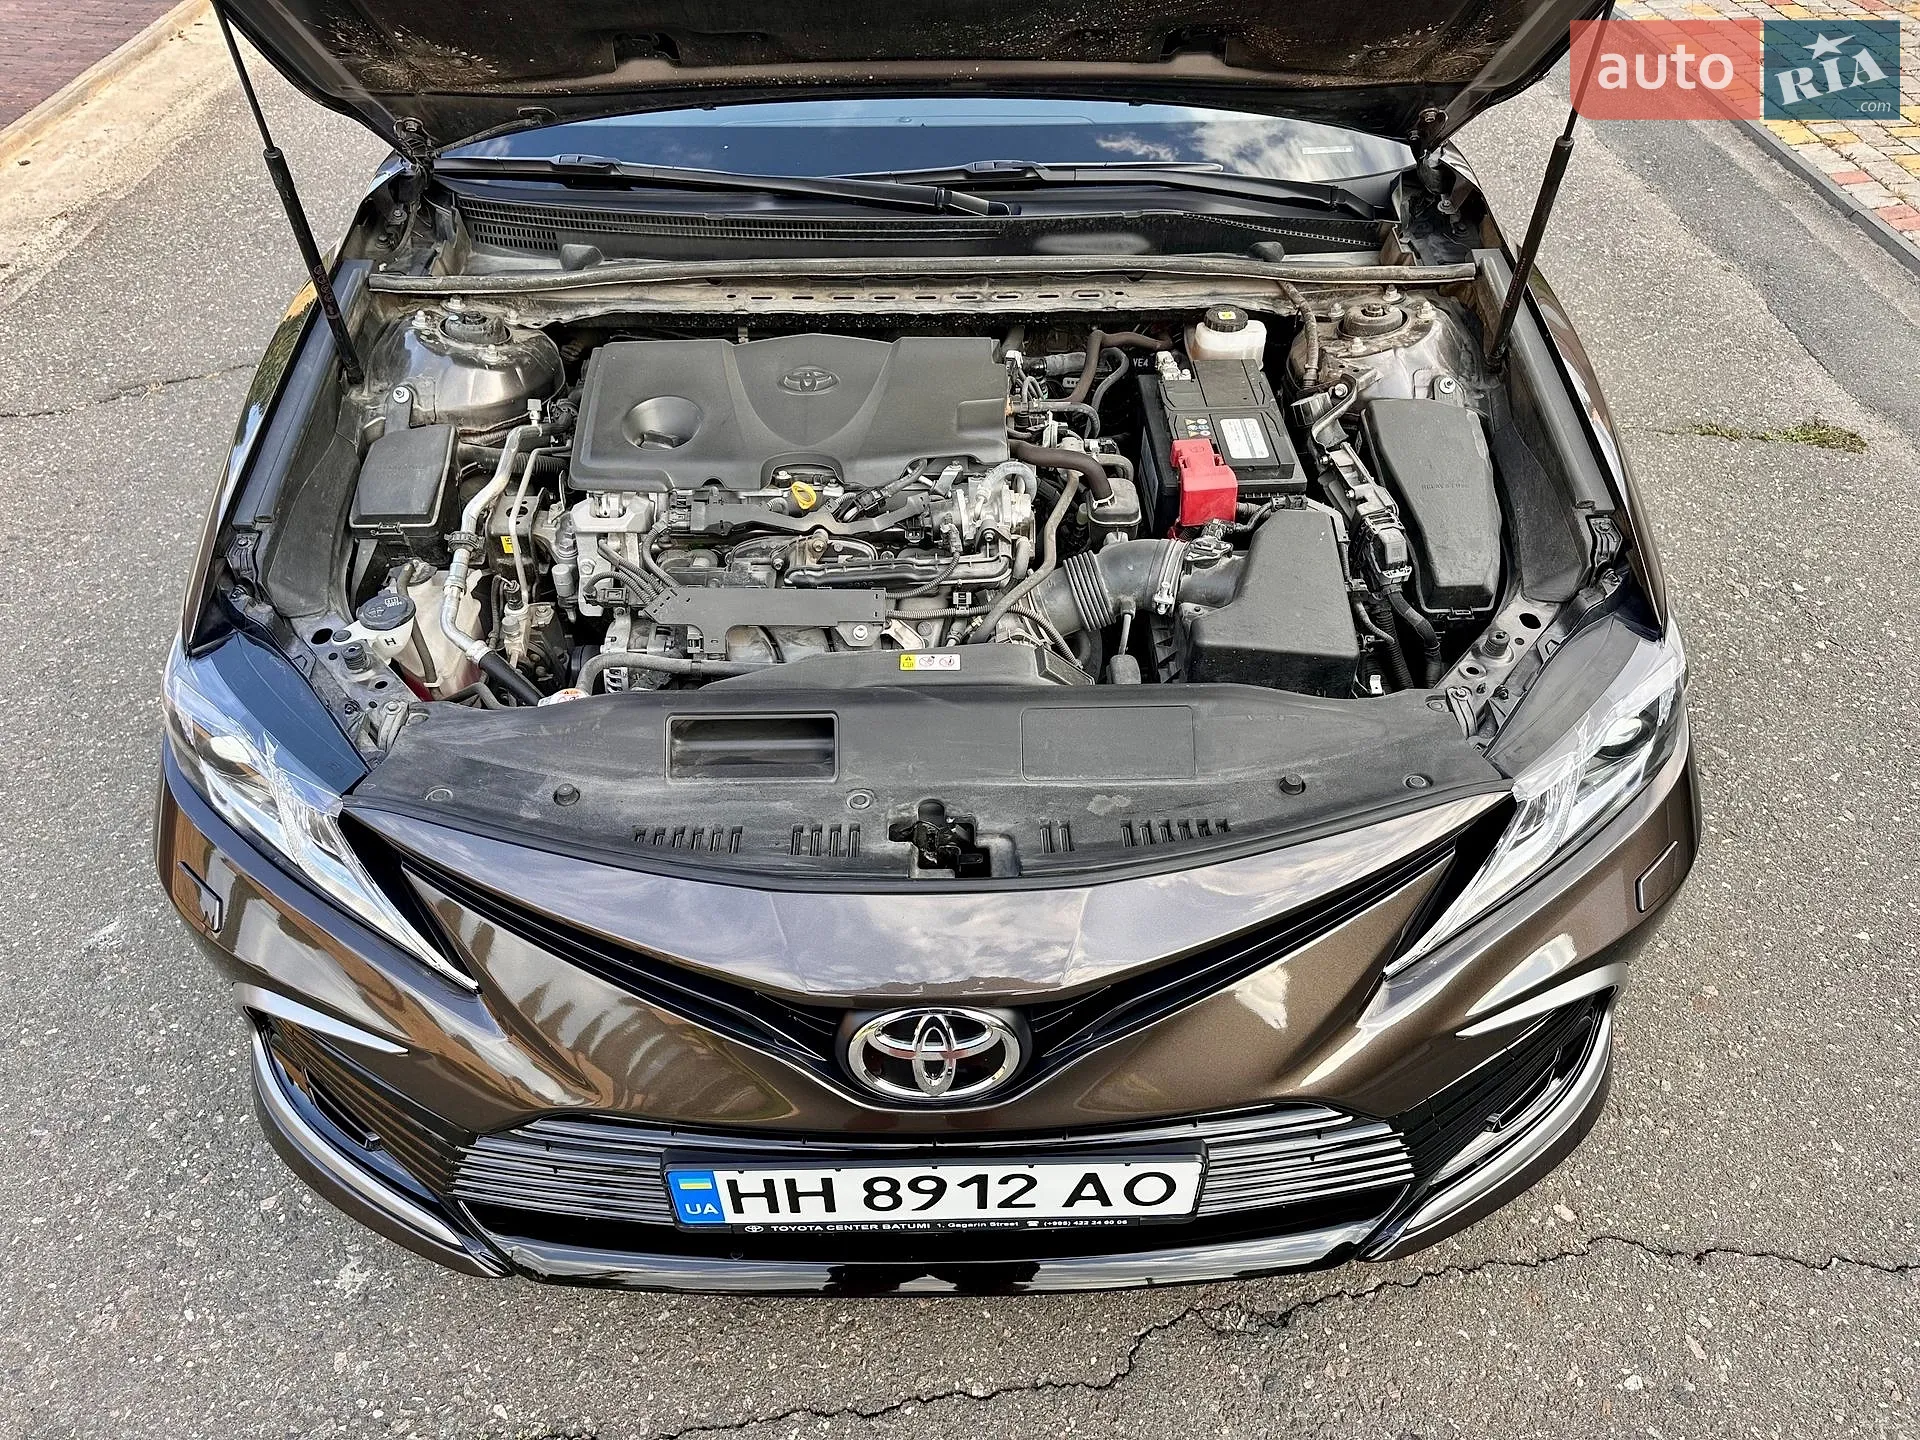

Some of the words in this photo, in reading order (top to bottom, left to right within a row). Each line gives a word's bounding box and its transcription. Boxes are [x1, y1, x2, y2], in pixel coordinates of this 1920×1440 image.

[384, 637, 397, 646] H
[863, 1174, 1037, 1211] 8912
[1062, 1172, 1177, 1207] AO
[685, 1203, 719, 1215] UA
[882, 1222, 931, 1230] BATUMI
